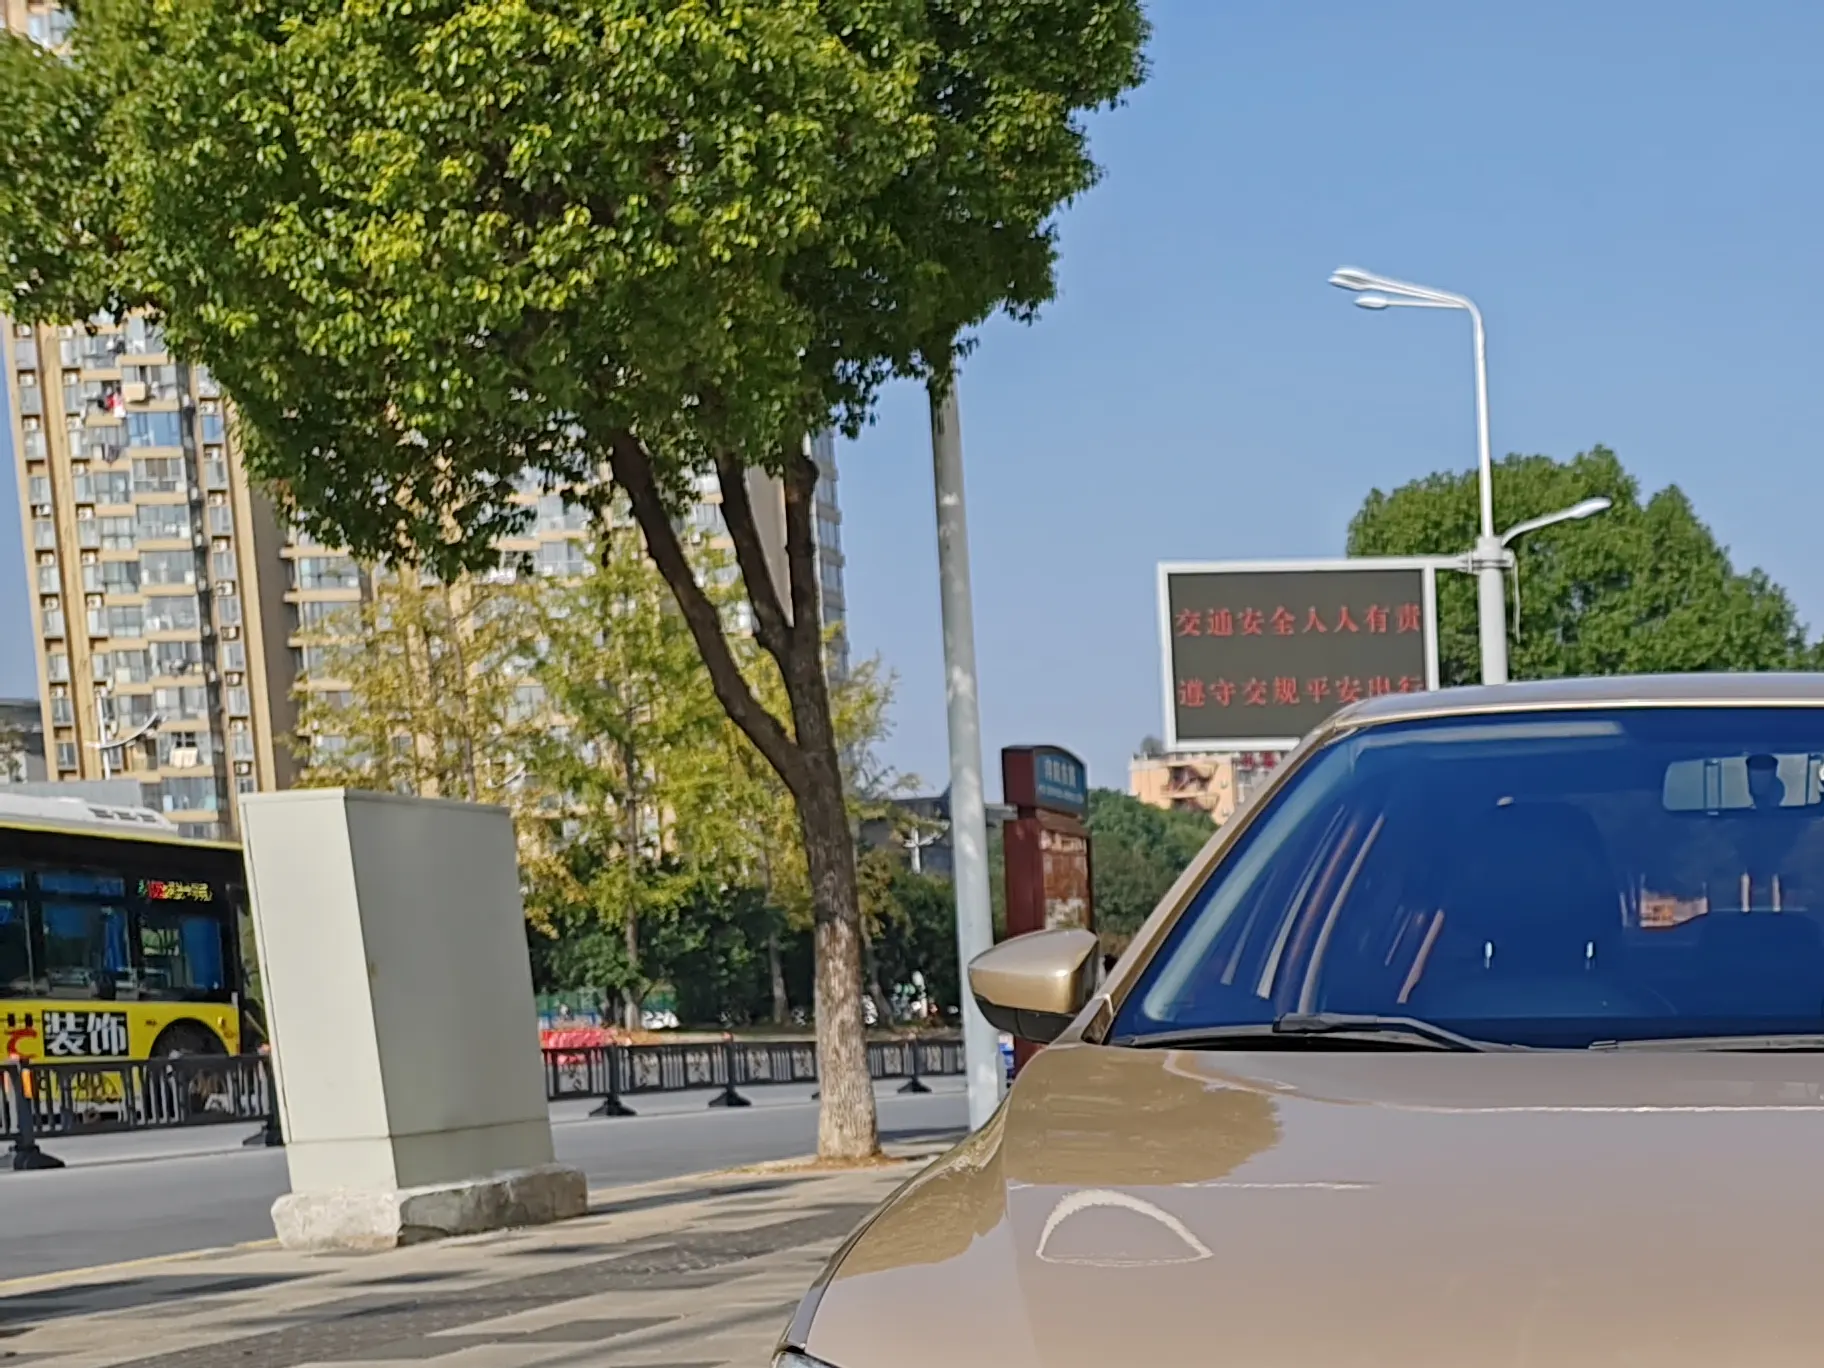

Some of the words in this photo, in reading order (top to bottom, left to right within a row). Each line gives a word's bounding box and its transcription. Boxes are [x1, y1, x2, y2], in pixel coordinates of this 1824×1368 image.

[1176, 602, 1421, 637] 交通安全人人有责
